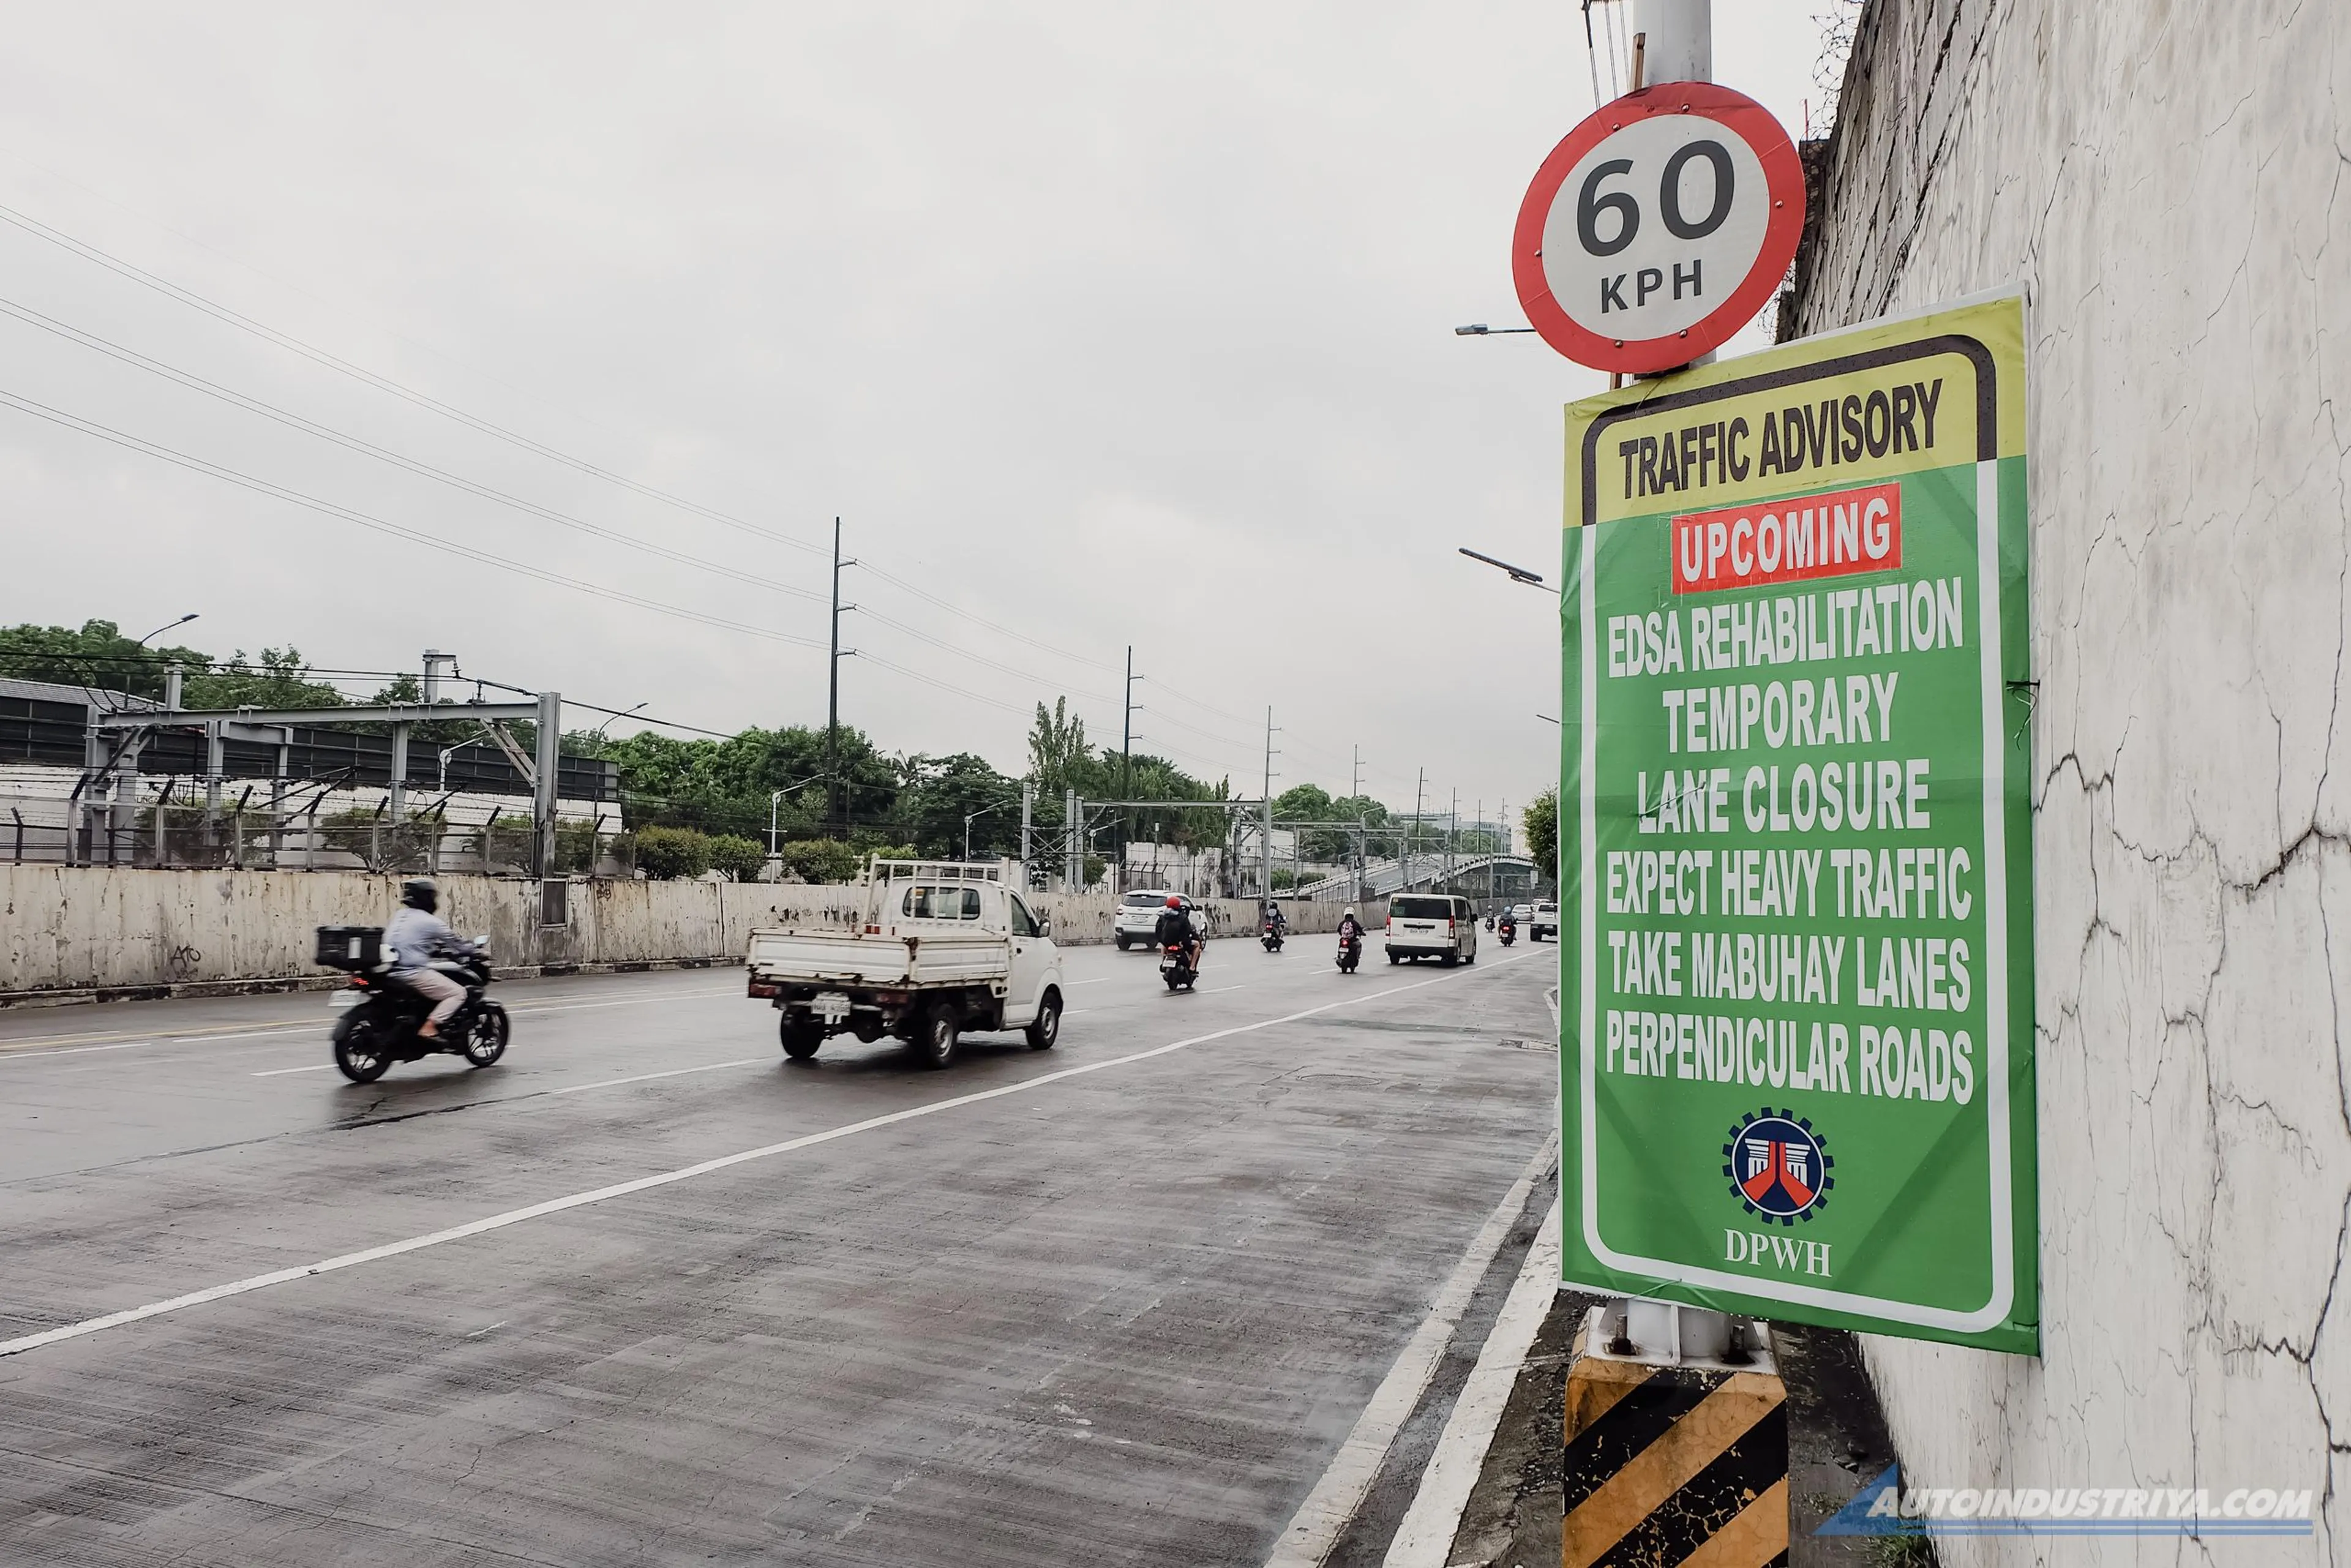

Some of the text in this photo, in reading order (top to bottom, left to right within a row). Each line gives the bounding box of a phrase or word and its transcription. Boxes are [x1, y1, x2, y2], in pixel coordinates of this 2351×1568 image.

[1577, 140, 1735, 257] 60
[1601, 259, 1703, 314] KPH
[1619, 378, 1944, 500] TRAFFIC ADVISORY
[1681, 497, 1891, 582] UPCOMING
[1608, 576, 1964, 678] EDSA REHABILITATION
[1662, 671, 1900, 754] TEMPORARY
[1638, 758, 1931, 834] LANE CLOSURE
[1606, 846, 1973, 920] EXPECT HEAVY TRAFFIC
[1608, 930, 1971, 1013] TAKE MABUHAY LANES
[1606, 1009, 1974, 1106] PERPENDICULAR ROADS
[1724, 1228, 1832, 1278] DPWH
